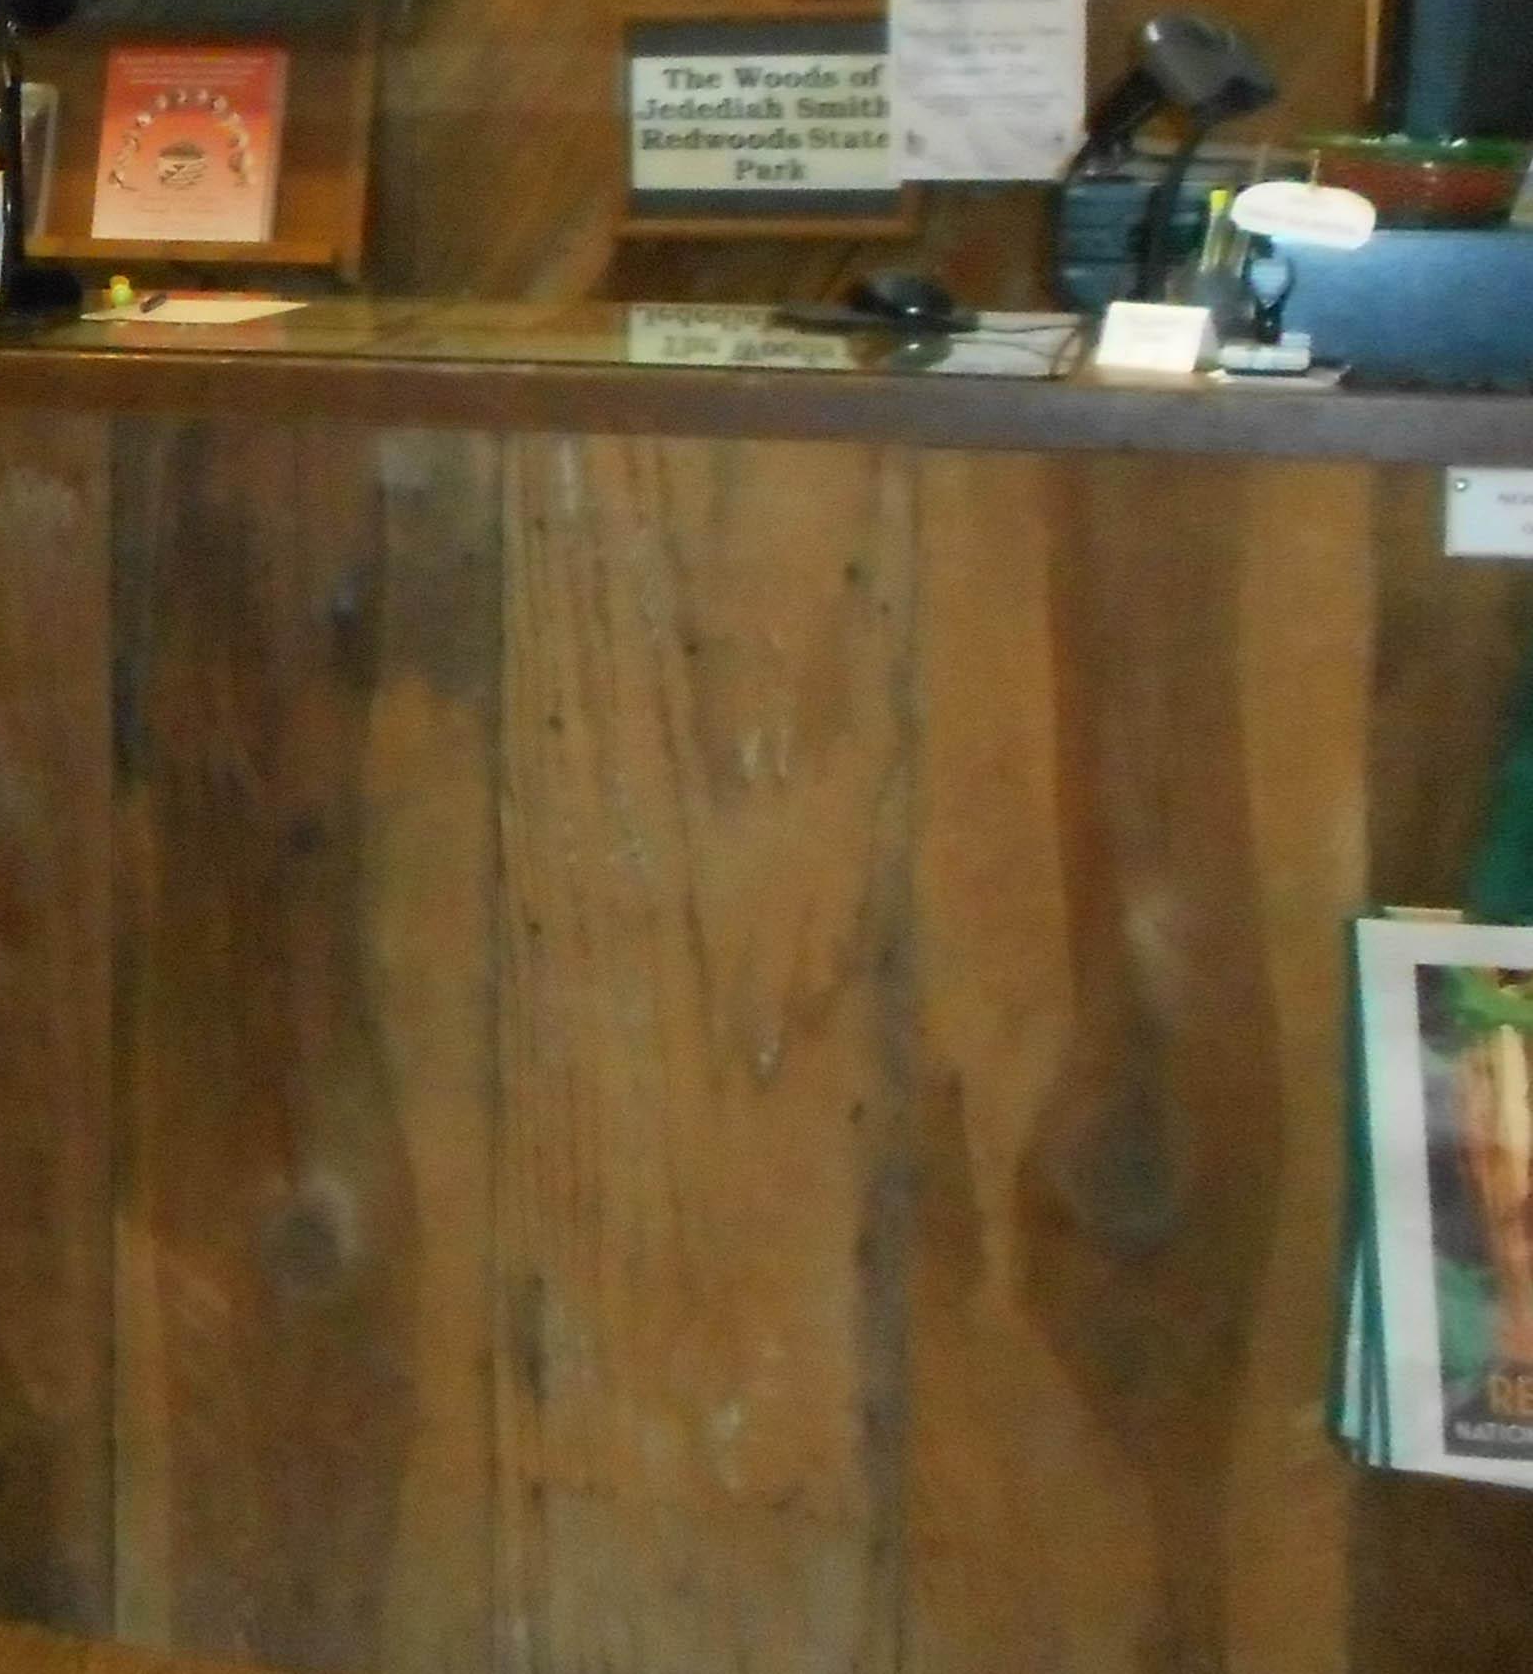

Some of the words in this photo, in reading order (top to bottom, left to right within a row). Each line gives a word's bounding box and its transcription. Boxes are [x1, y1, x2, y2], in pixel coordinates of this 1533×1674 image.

[663, 67, 722, 91] The
[734, 66, 835, 90] Woods
[850, 61, 885, 88] of
[635, 97, 784, 120] Jedediah
[641, 128, 803, 151] Redwoods
[808, 127, 890, 150] State
[734, 159, 806, 182] Park
